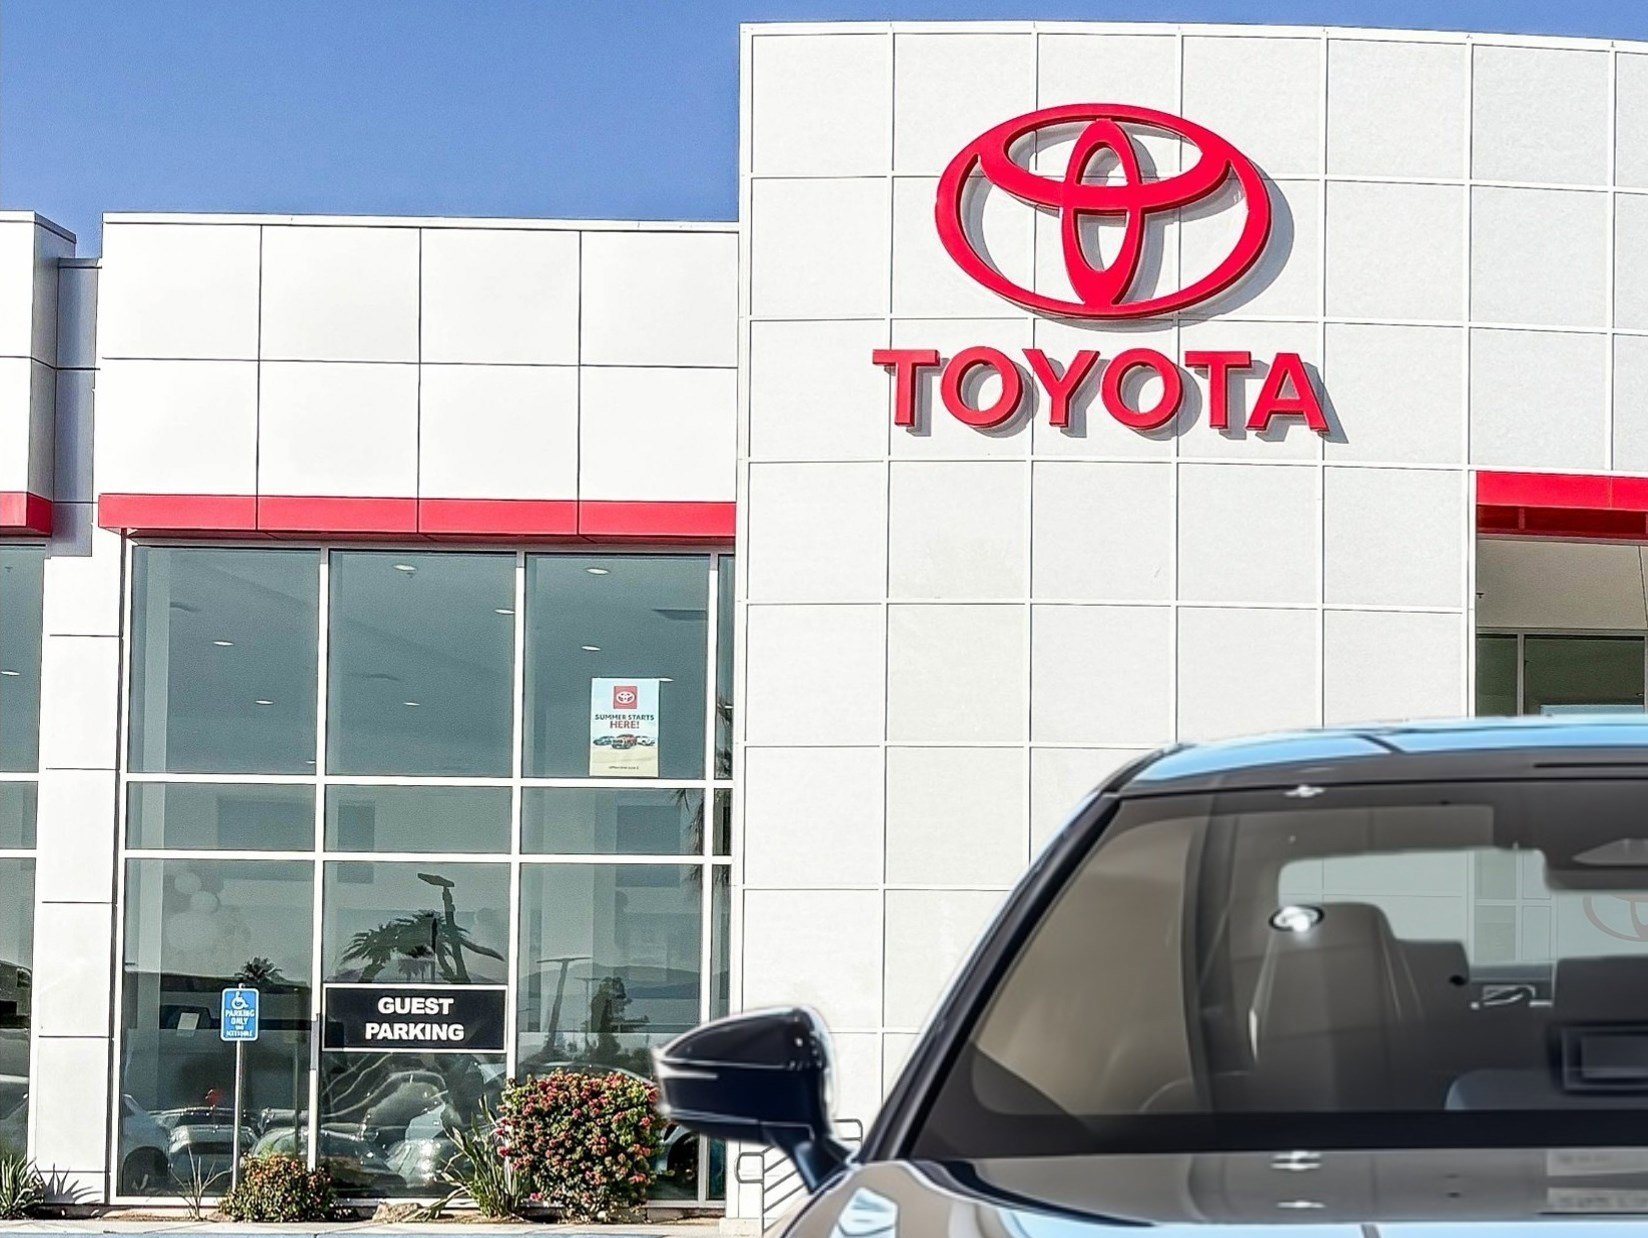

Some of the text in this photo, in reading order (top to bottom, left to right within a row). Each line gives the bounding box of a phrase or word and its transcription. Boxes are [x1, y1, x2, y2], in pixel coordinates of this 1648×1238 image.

[872, 346, 1330, 434] TOYOTA
[610, 720, 640, 729] HERE!
[377, 997, 455, 1015] GUEST
[365, 1022, 465, 1041] PARKING
